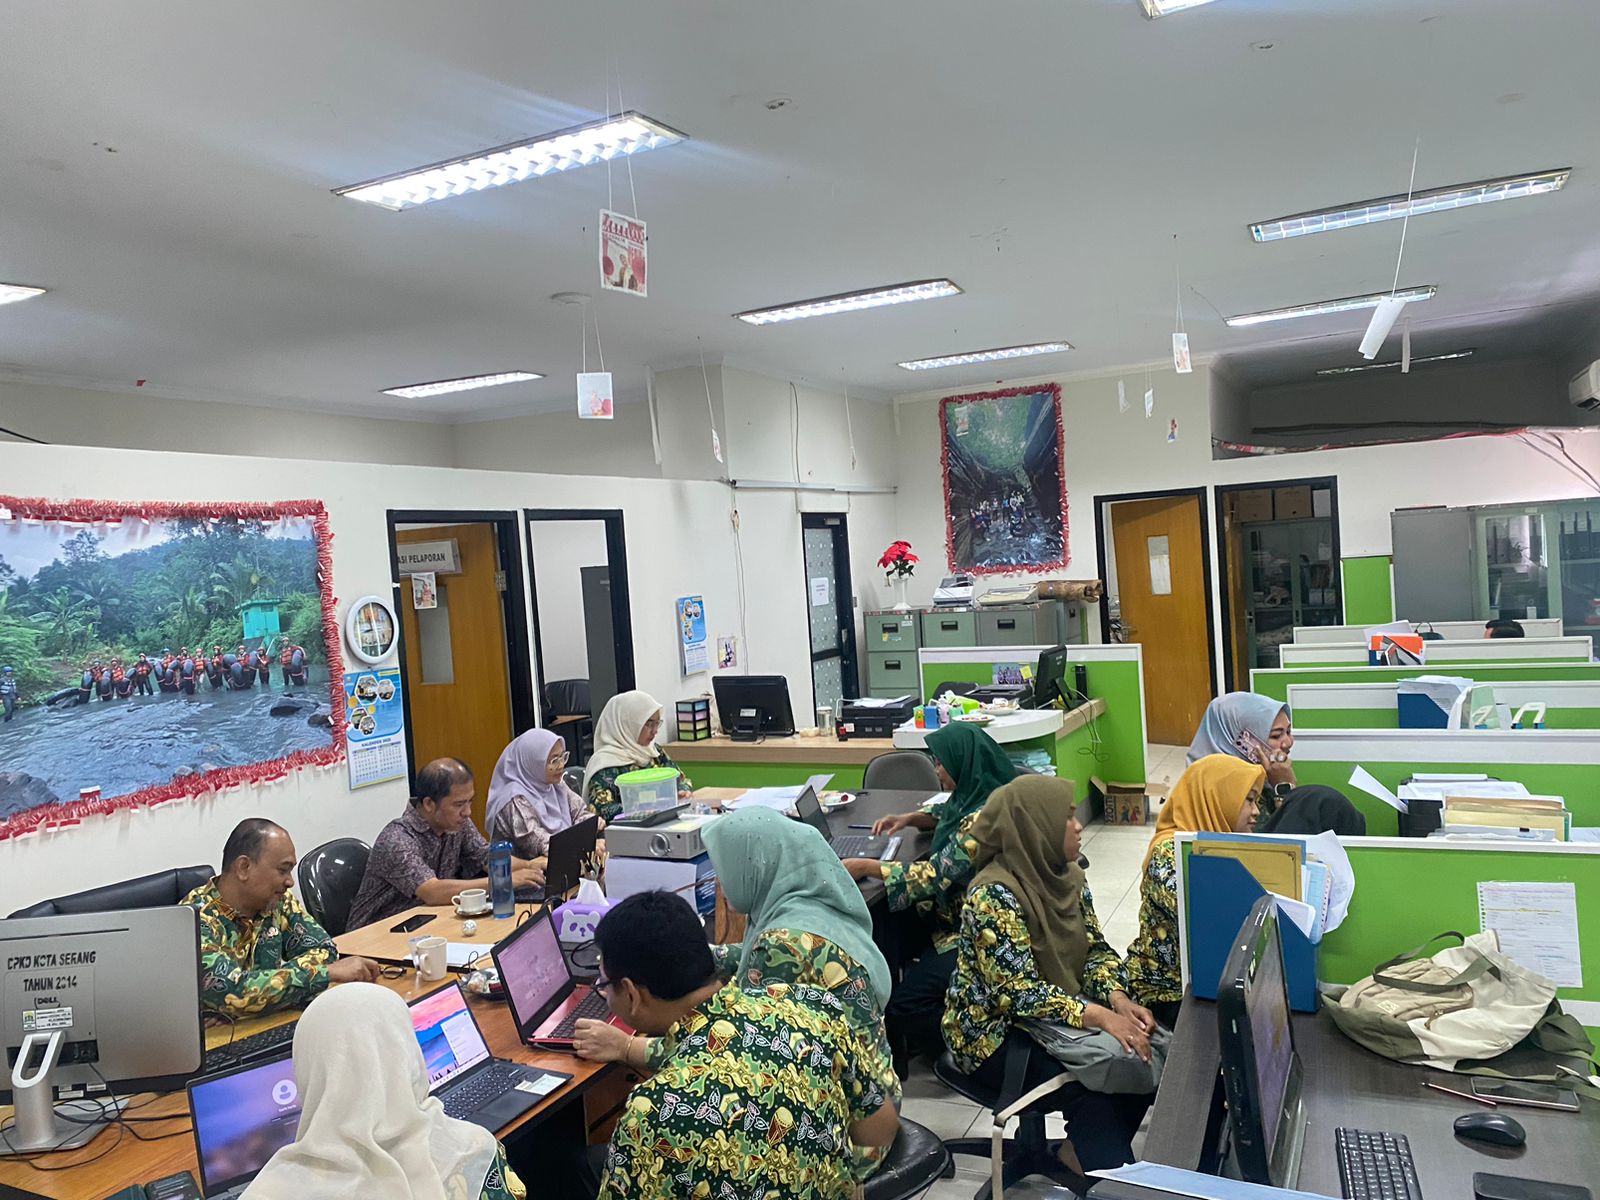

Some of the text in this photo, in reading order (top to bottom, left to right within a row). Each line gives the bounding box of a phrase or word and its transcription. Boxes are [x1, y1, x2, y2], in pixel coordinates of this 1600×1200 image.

[409, 552, 446, 564] PELAPORAN
[33, 953, 57, 968] KOTA
[59, 950, 96, 966] SERANG
[23, 975, 77, 992] TAHUN 2014
